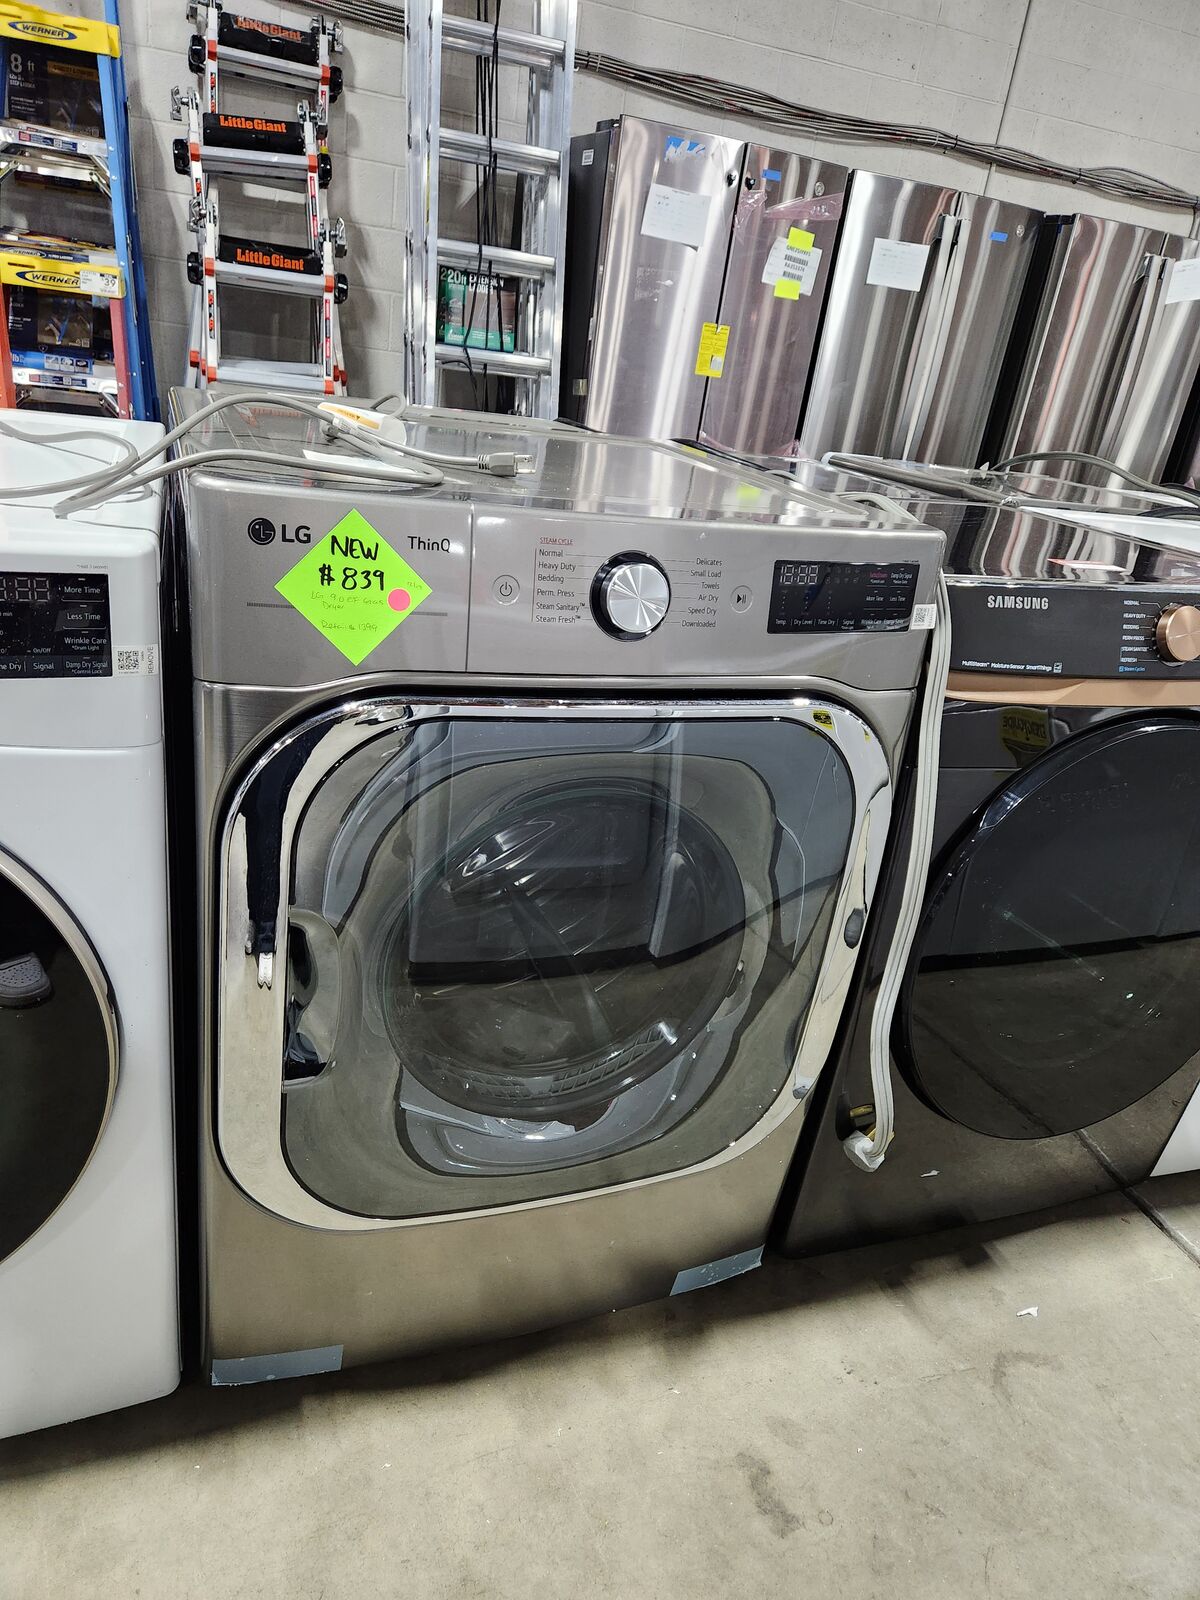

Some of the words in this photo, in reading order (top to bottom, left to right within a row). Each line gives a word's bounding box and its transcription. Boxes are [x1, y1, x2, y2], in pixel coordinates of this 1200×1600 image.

[22, 23, 65, 37] WERNER
[10, 53, 22, 73] 8
[28, 60, 35, 72] ft
[32, 273, 80, 285] WERNER
[281, 523, 311, 544] LG
[407, 535, 450, 553] ThinQ
[540, 537, 557, 545] STEAM
[330, 535, 379, 561] NEW
[539, 548, 564, 557] Normal
[538, 561, 559, 571] Heavy
[560, 562, 576, 572] Duty
[696, 558, 722, 566] Delicates
[690, 569, 706, 577] Small
[708, 570, 721, 578] Load
[538, 574, 565, 584] Bedding
[64, 586, 82, 594] More
[84, 586, 100, 594] Time
[537, 588, 556, 597] Perm.
[557, 589, 575, 597] Press
[708, 594, 719, 603] Dry
[987, 595, 1049, 610] SAMSUNG
[536, 602, 555, 610] Steam
[688, 607, 705, 615] Speed
[706, 607, 716, 616] Dry
[536, 615, 556, 623] Steam
[682, 620, 716, 628] Downloaded
[9, 662, 22, 671] Dry
[33, 662, 55, 671] Signal
[92, 661, 108, 669] Signal
